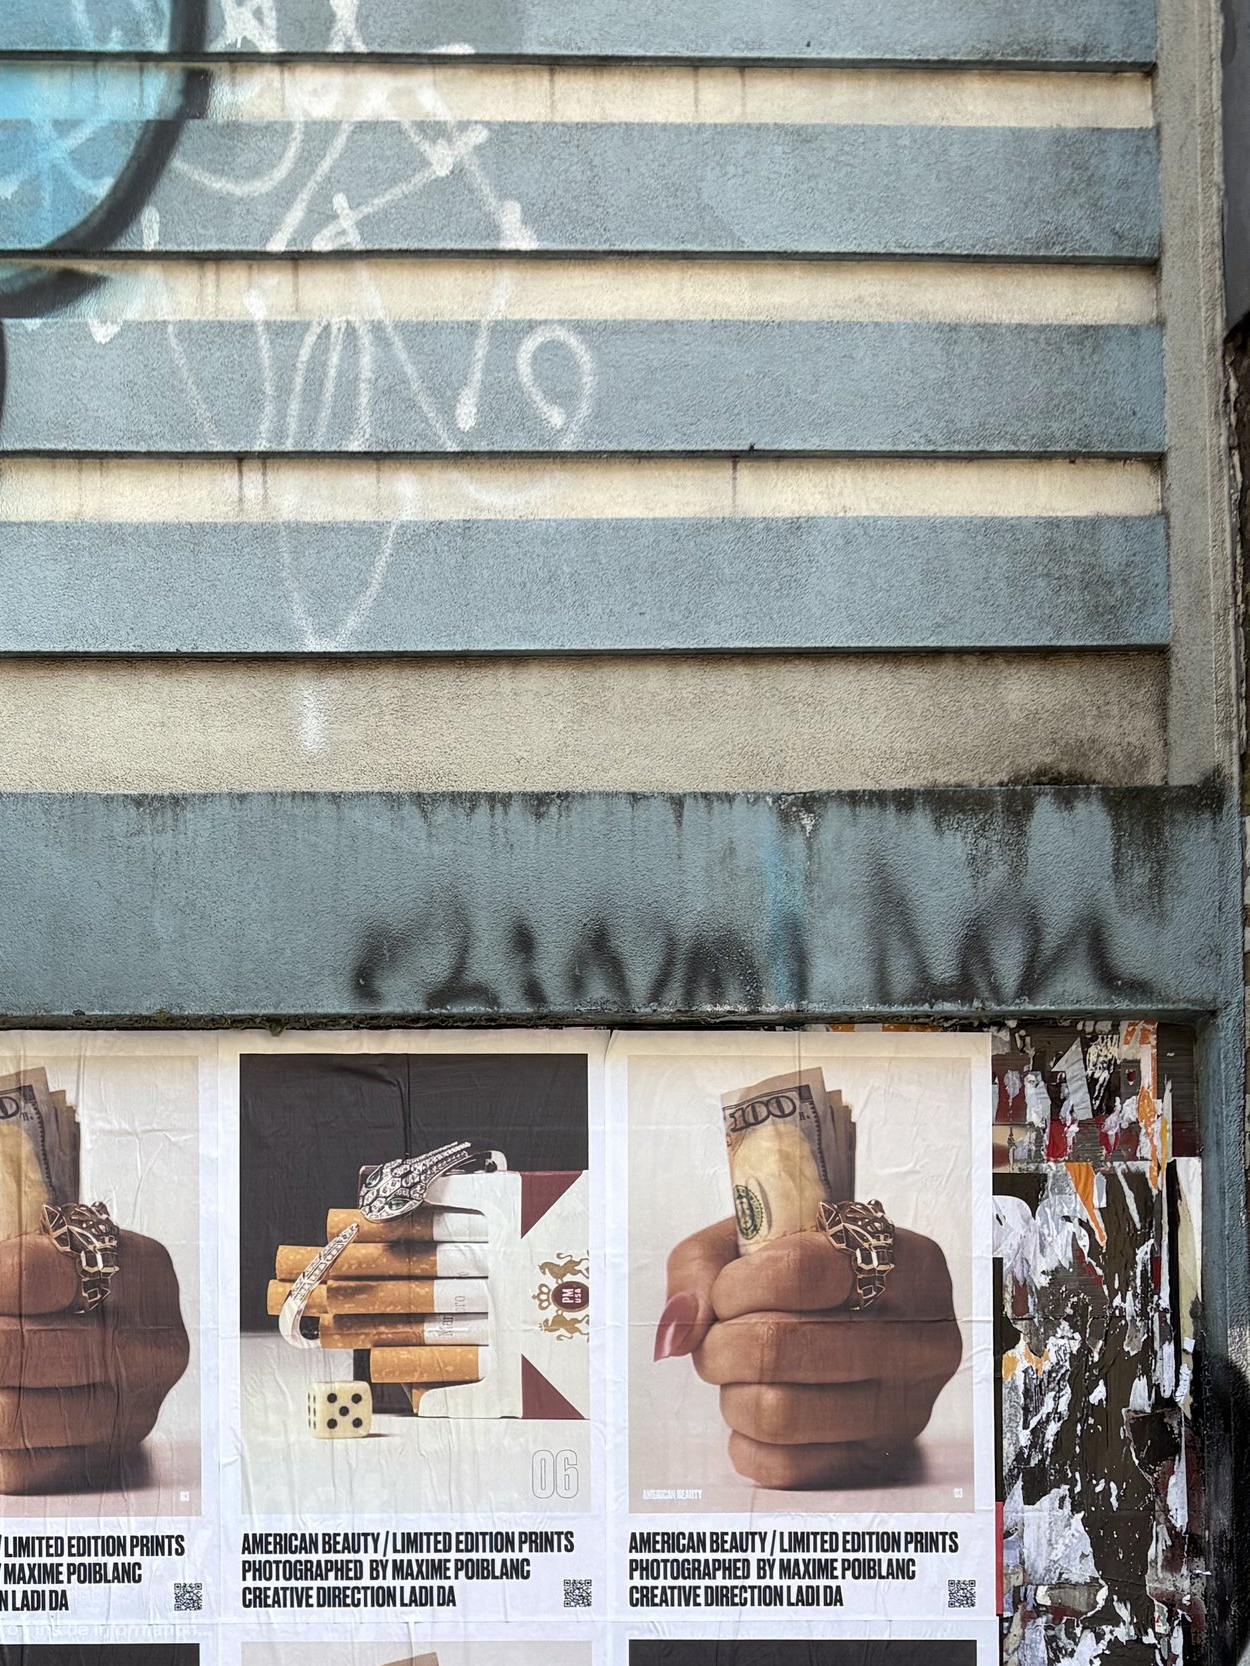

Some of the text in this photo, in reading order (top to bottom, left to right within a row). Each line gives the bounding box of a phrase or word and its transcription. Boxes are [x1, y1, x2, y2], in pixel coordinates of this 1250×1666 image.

[729, 1094, 797, 1133] 100
[531, 1449, 579, 1499] 06
[629, 1531, 706, 1553] AMERICAN
[709, 1531, 766, 1552] BEAUTY
[779, 1531, 838, 1552] LIMITED
[842, 1531, 900, 1552] EDITION
[904, 1531, 958, 1552] PRINTS
[629, 1558, 915, 1580] PHOTOGRAPHED BY MAXIME POIBLANC
[629, 1585, 843, 1606] CREATIVE DIRECTION LADI DA
